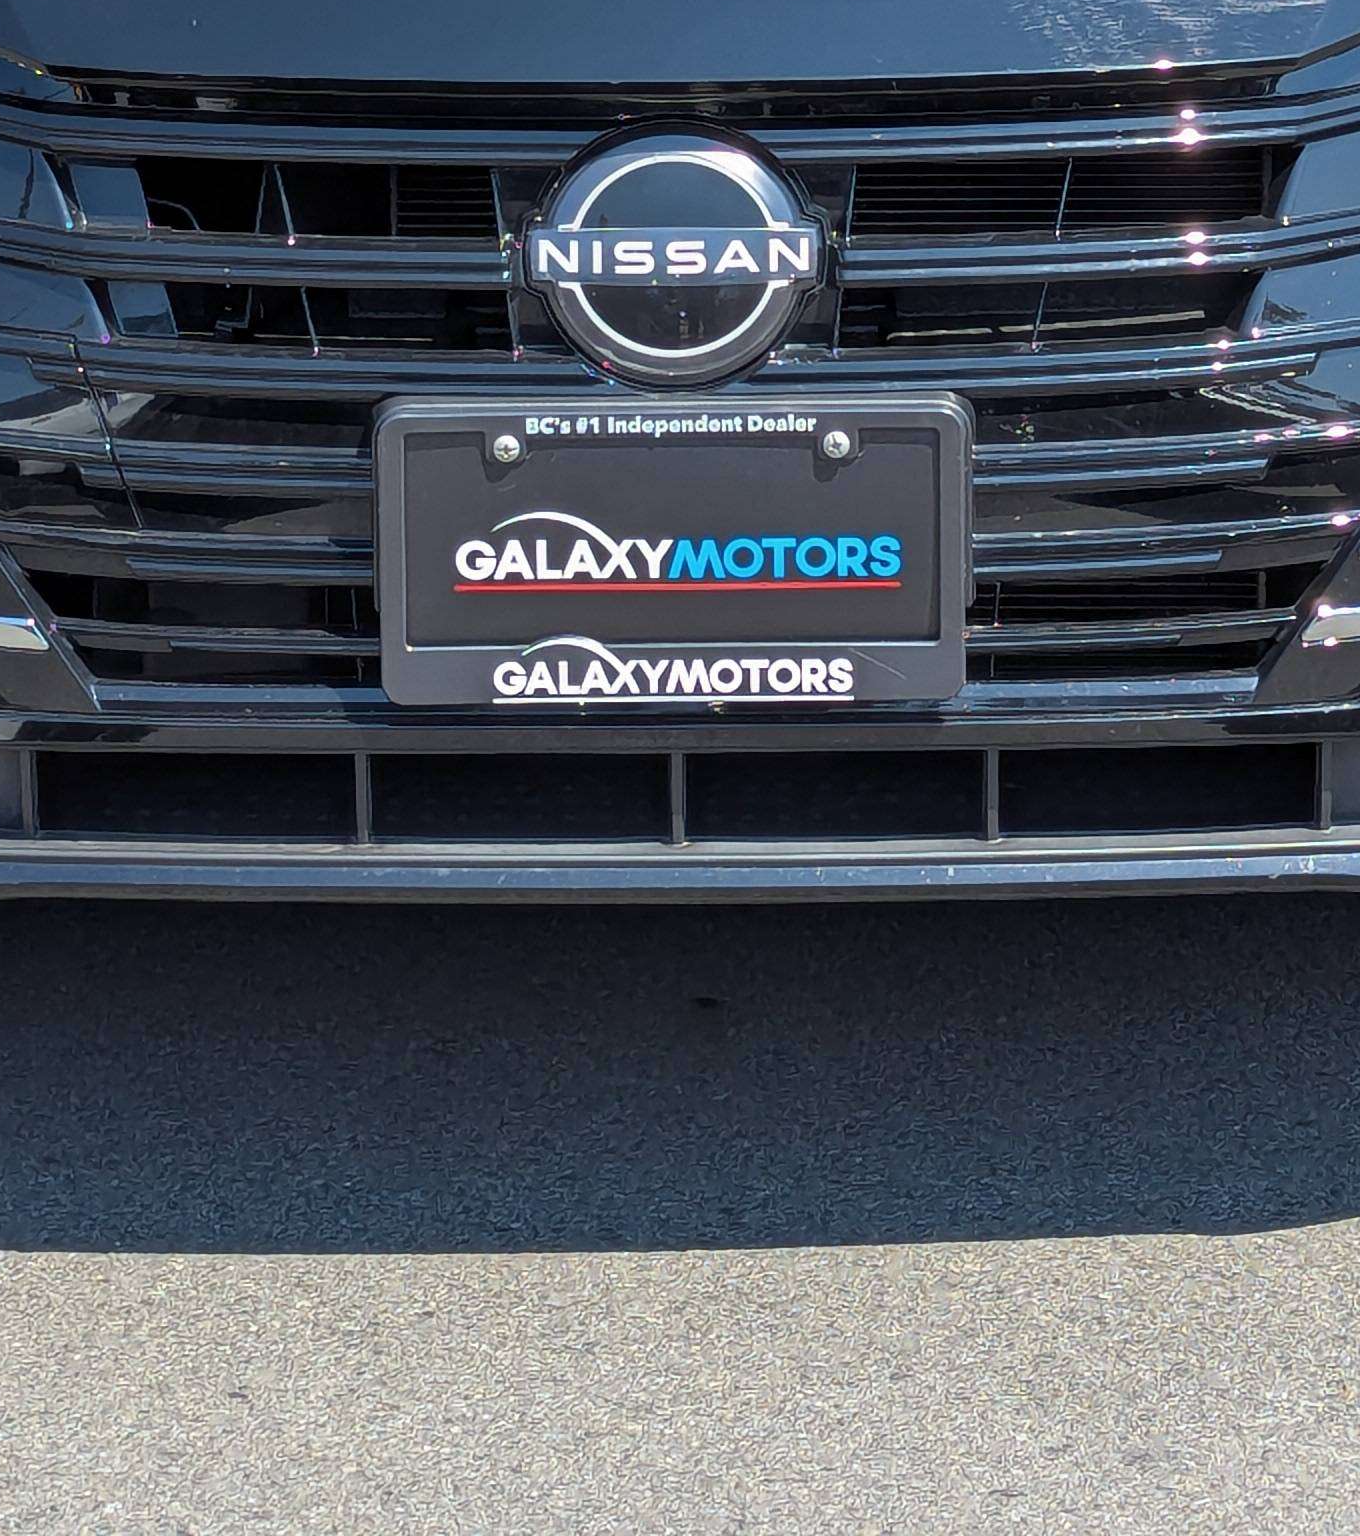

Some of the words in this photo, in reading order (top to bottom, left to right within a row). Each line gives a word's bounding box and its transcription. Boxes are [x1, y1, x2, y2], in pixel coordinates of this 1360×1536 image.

[538, 237, 811, 275] NISSAN
[525, 417, 571, 435] BC's
[575, 416, 600, 435] #1
[607, 414, 742, 438] Independent
[747, 413, 817, 434] Dealer
